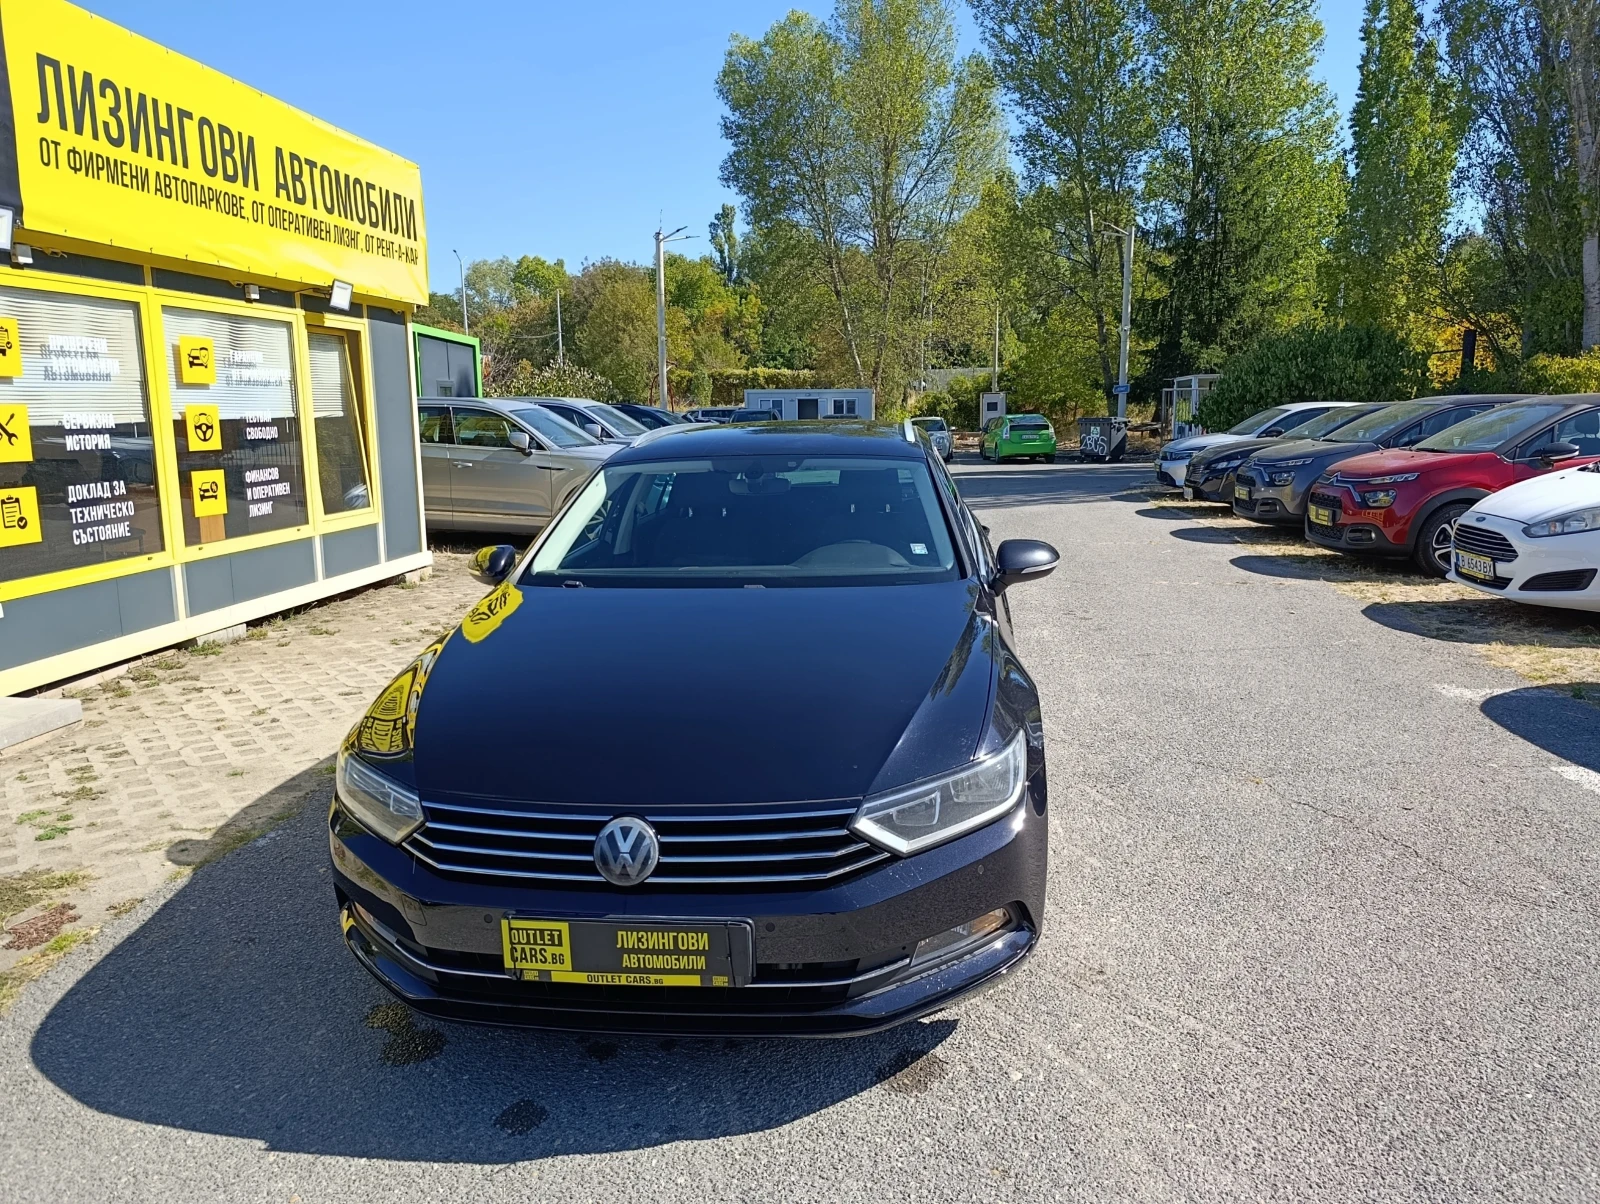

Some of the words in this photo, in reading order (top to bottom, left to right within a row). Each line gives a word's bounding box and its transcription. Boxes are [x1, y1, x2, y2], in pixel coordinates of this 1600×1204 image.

[36, 52, 260, 192] ЛИЗИНГОВИ
[274, 146, 418, 242] АВТОМОБИЛИ
[39, 137, 61, 170] ОТ
[67, 146, 150, 194] ФИРМЕНИ
[154, 171, 249, 223] АВТОПАРКОВЕ,
[252, 200, 265, 224] ОТ
[268, 205, 331, 243] ОПЕРАТИВЕН
[365, 234, 375, 253] ОТ
[63, 413, 116, 430] СЕРВИЗНА
[246, 426, 279, 440] СВОБОДНО
[65, 434, 111, 451] ИСТОРИЯ
[245, 467, 279, 483] ФИНАНСОВ
[68, 481, 112, 503] ДОКЛАД
[113, 480, 126, 495] ЗА
[246, 487, 252, 501] И
[252, 482, 291, 500] ОПЕРАТИВЕН
[69, 501, 135, 524] ТЕХНИЧЕСКО
[249, 501, 273, 518] ЛИЗИНГ
[73, 521, 131, 545] СЪСТОЯНИЕ
[511, 929, 560, 945] OUTLET
[616, 930, 709, 951] ЛИЗИНГОВИ
[510, 946, 565, 965] CARS.BG
[622, 954, 706, 970] АВТОМОБИЛИ
[586, 974, 622, 984] OUTLET
[625, 975, 664, 985] CARS.BG
